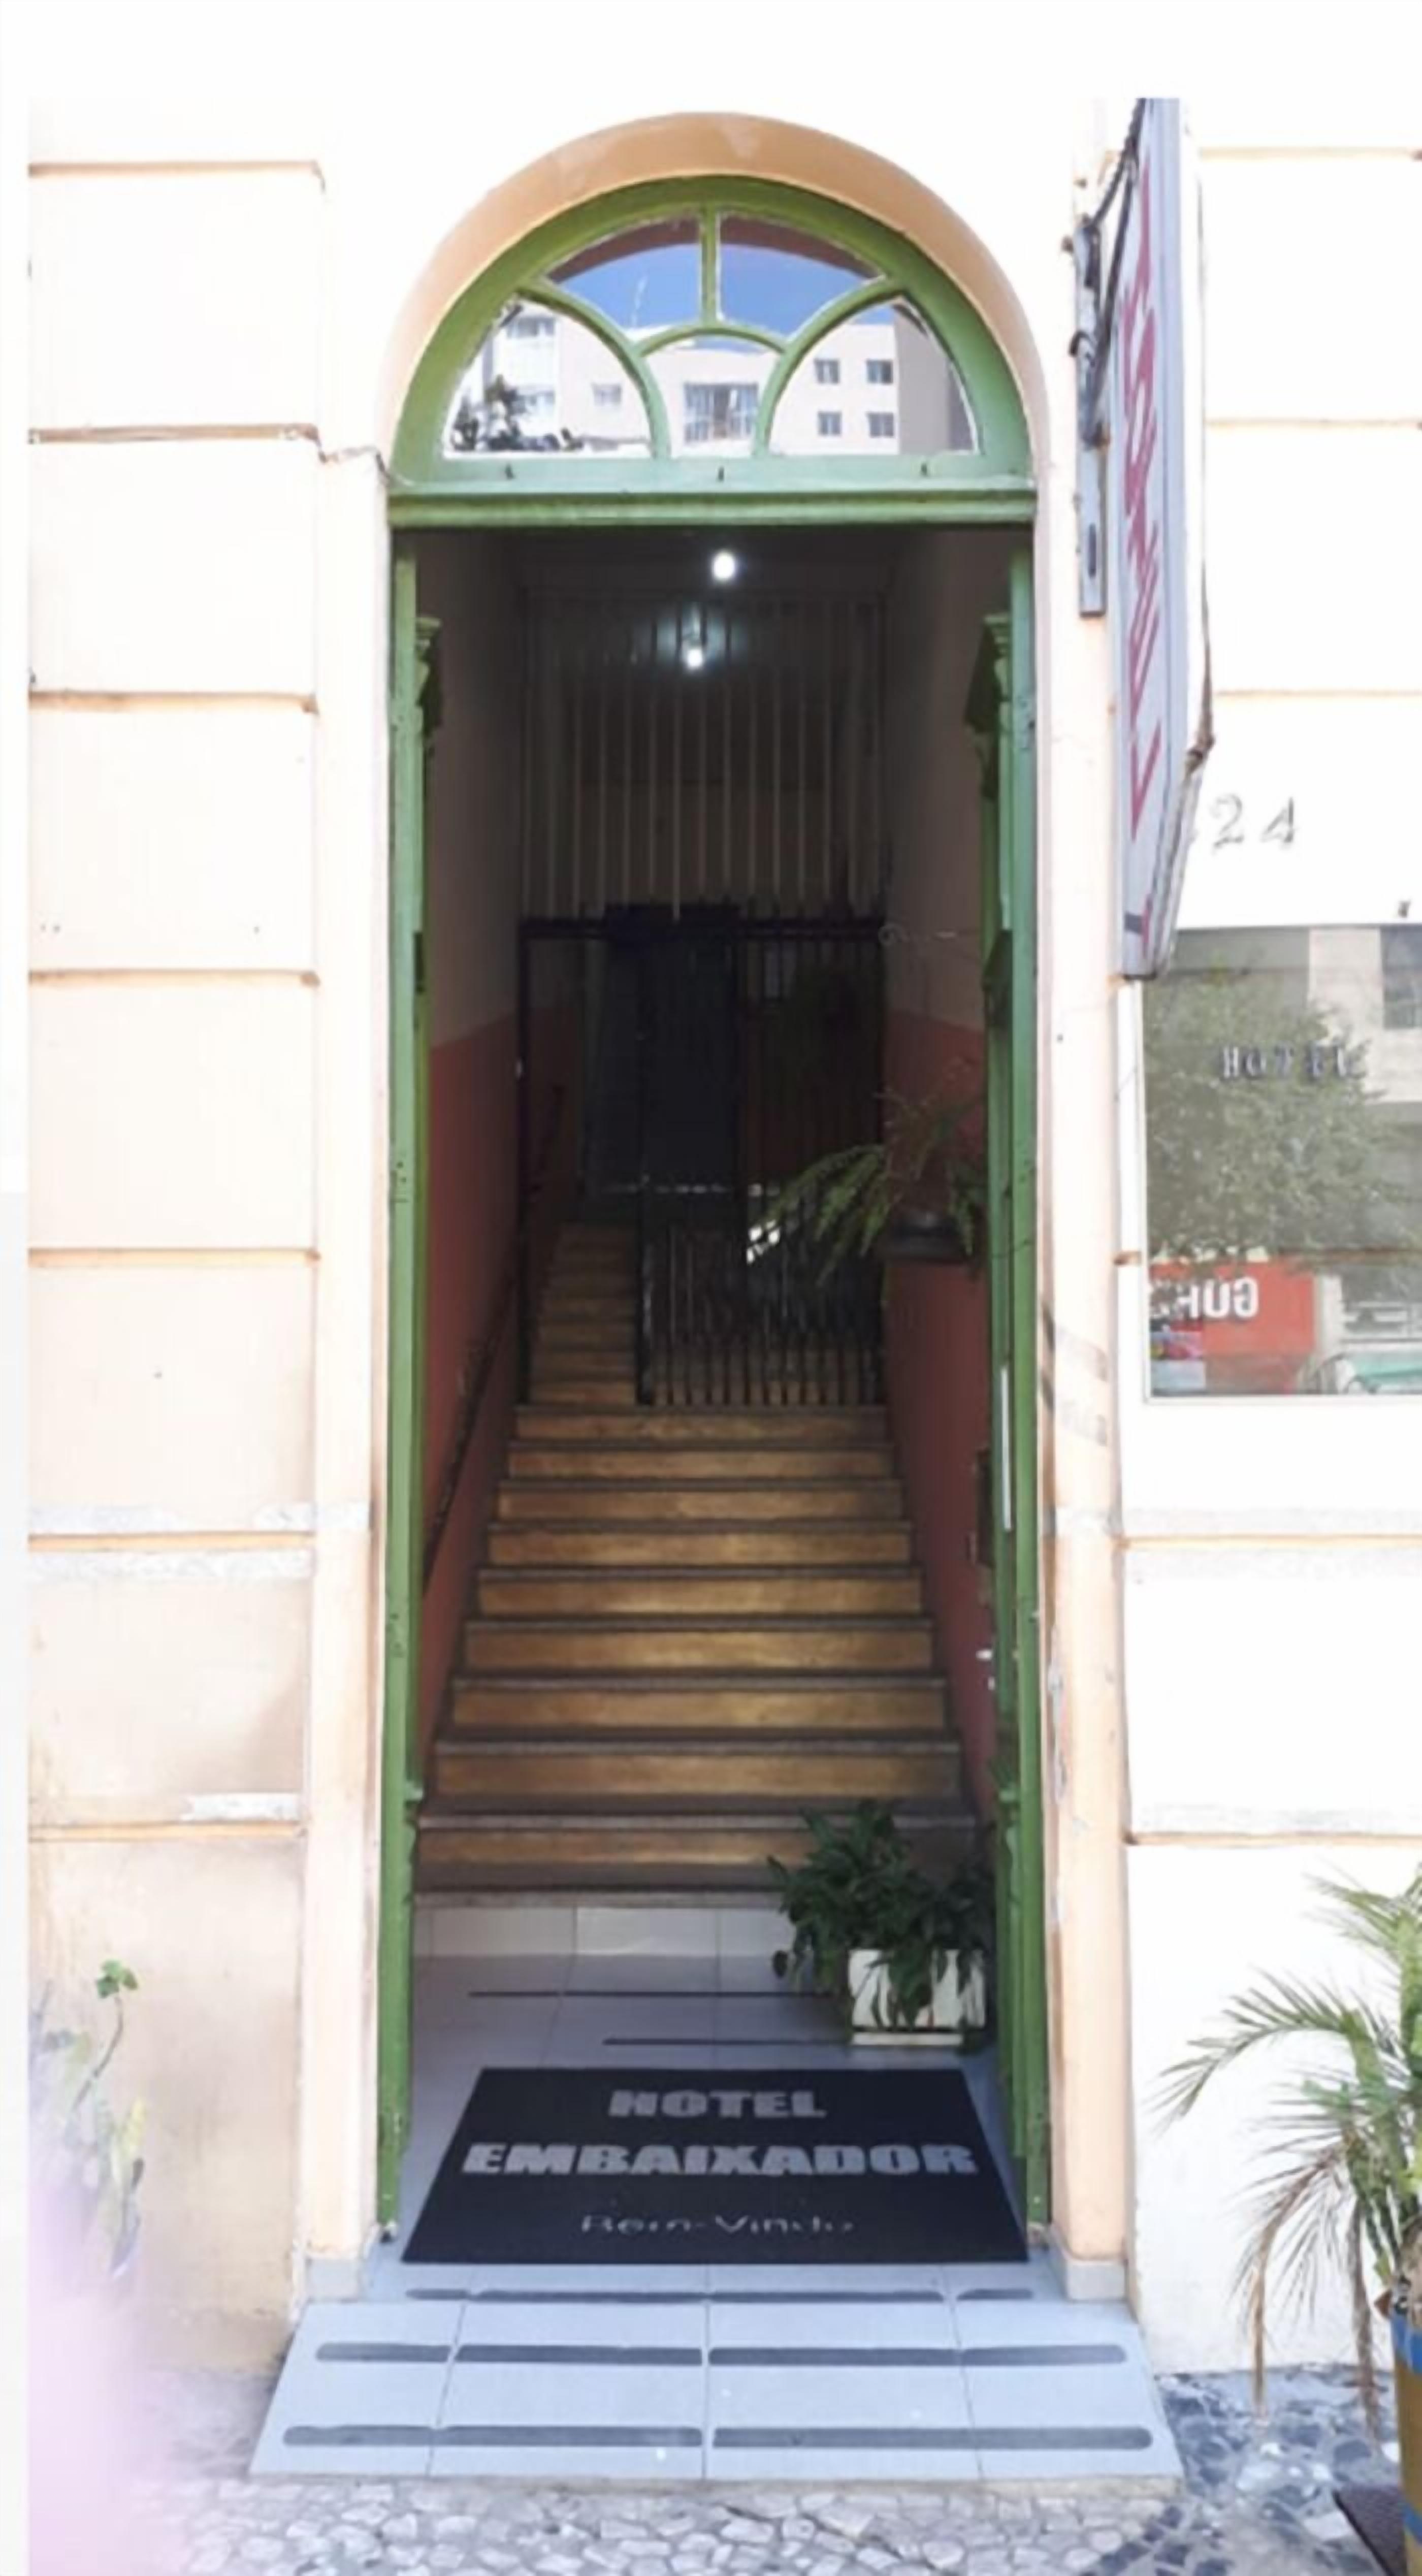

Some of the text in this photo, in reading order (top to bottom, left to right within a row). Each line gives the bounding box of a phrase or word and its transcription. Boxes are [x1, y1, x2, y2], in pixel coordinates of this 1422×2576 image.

[1194, 793, 1296, 849] 24
[1221, 1044, 1365, 1080] HOTEL
[608, 2088, 828, 2118] HOTEL
[460, 2142, 978, 2175] EMBAIXADOR
